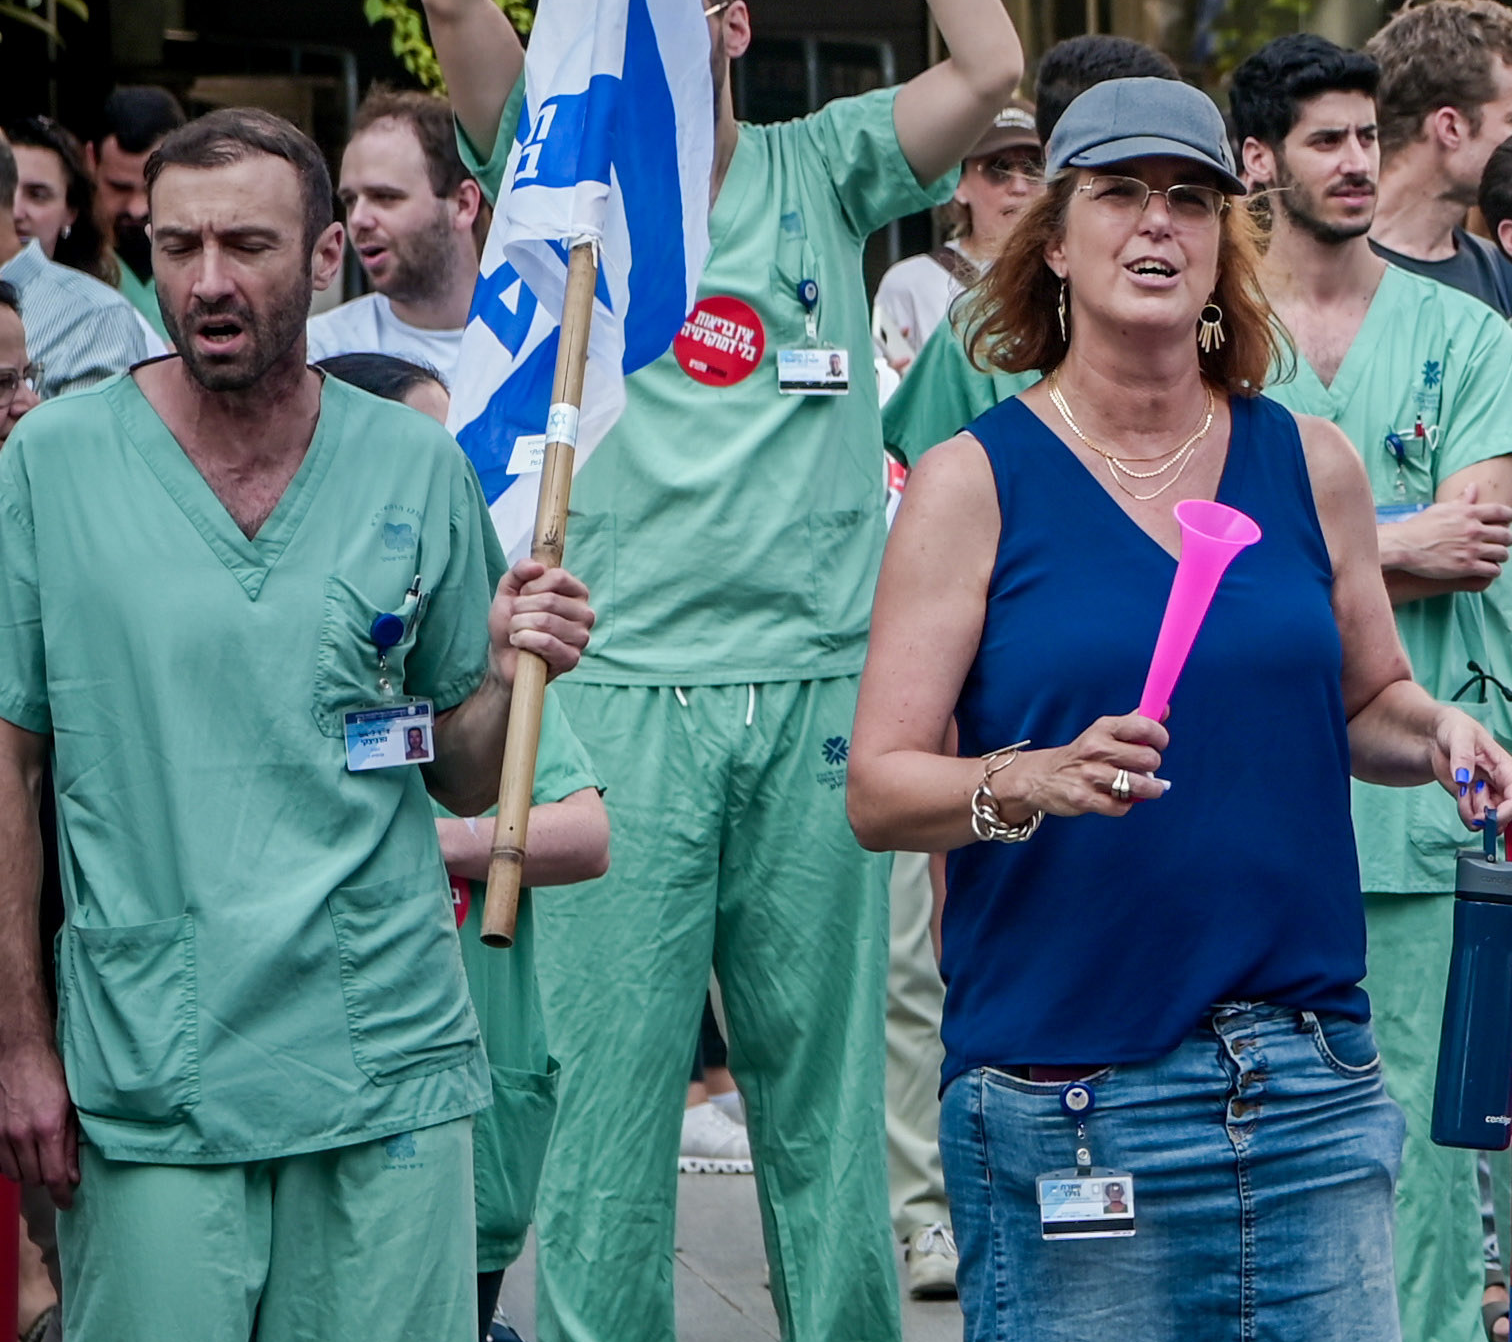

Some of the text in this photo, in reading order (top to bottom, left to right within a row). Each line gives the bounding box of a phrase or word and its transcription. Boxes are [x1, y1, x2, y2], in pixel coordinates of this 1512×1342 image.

[680, 321, 739, 355] דמוקרטיה
[694, 310, 755, 346] אין בריאות
[738, 341, 757, 362] בלי
